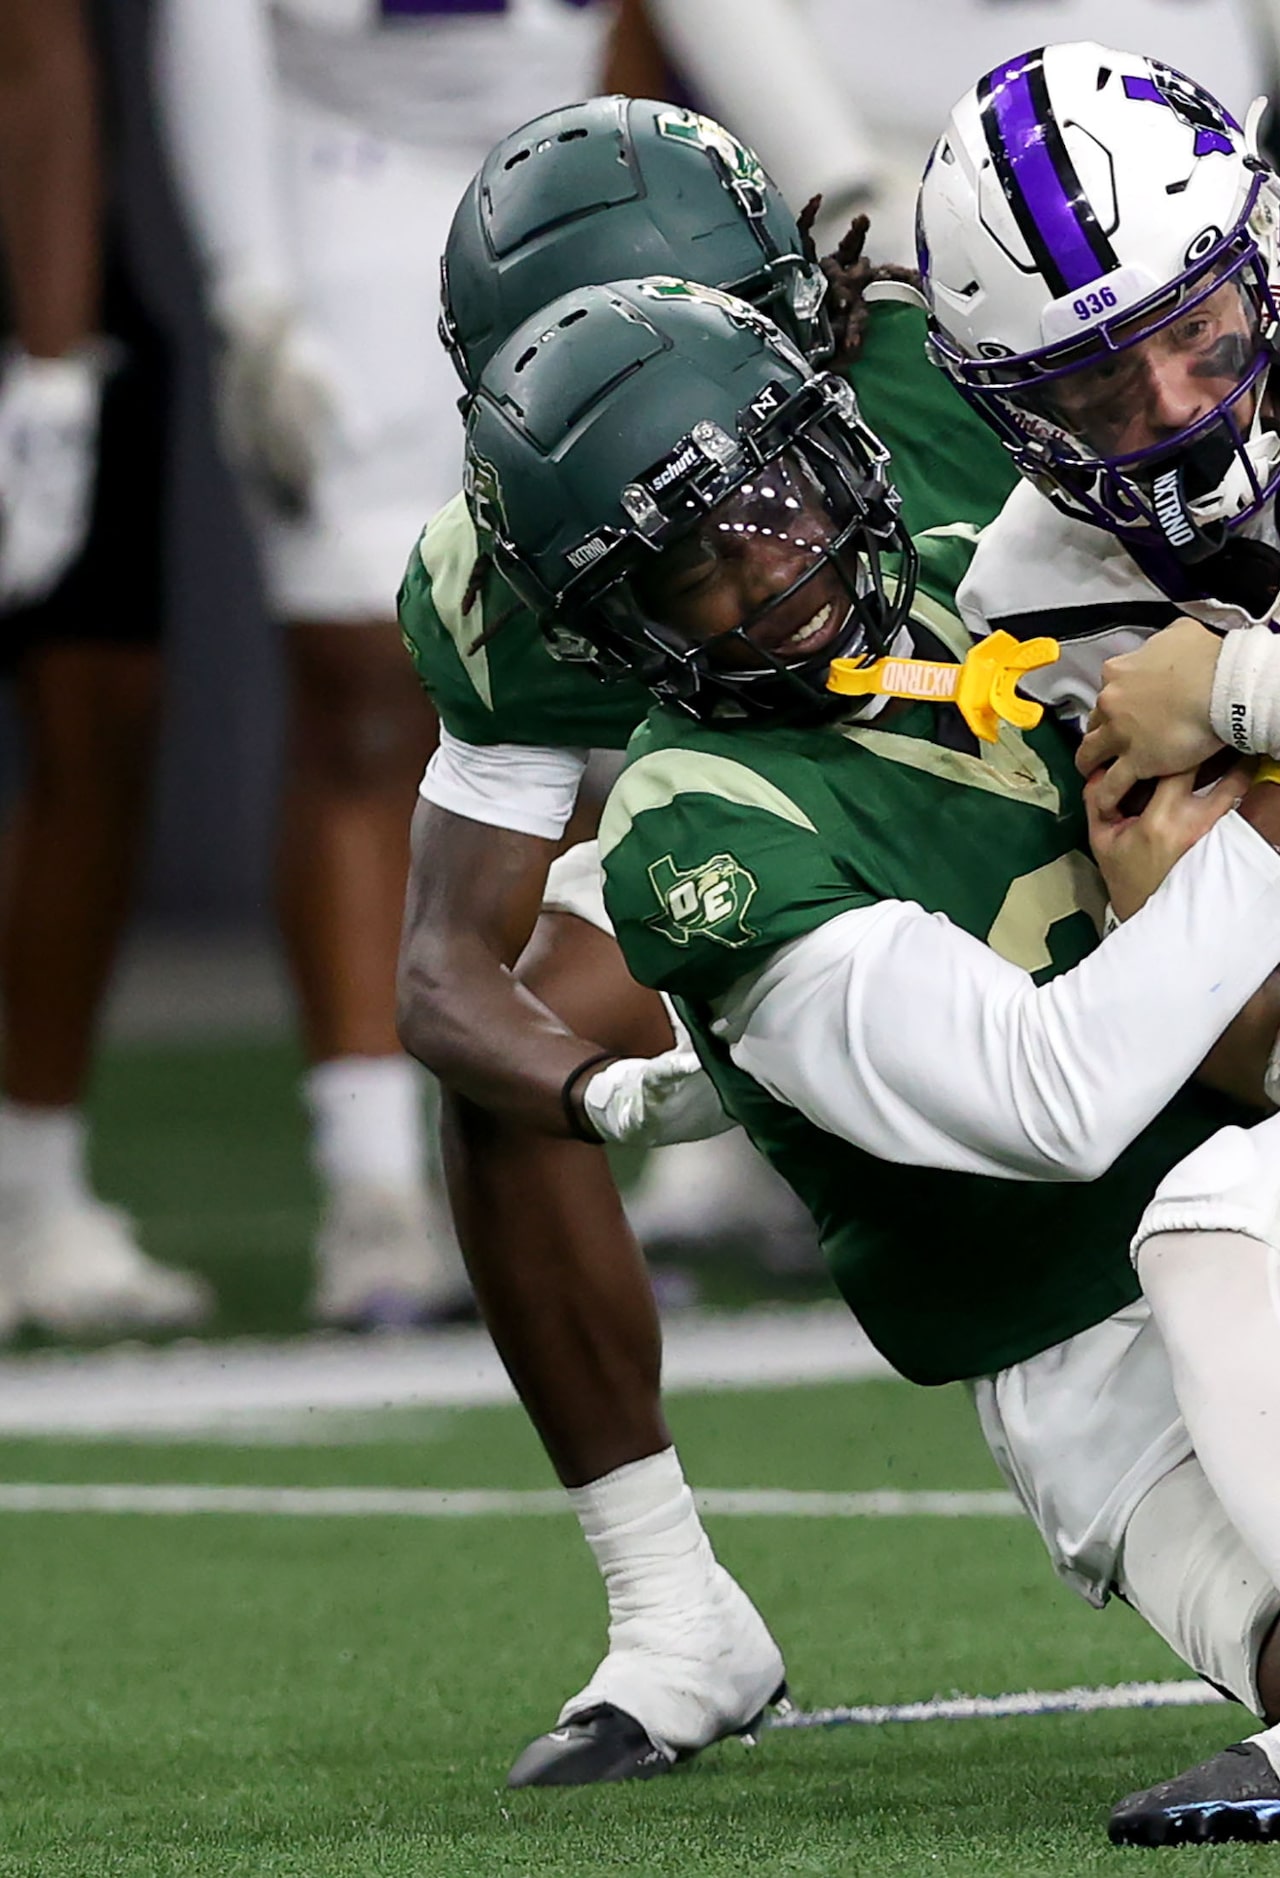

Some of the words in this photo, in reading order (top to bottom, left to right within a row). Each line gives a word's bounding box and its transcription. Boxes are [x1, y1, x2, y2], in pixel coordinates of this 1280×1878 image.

[1073, 286, 1117, 320] 936
[652, 447, 699, 491] schutt
[1153, 469, 1196, 546] NXTRND
[566, 538, 608, 569] NXTRND
[881, 661, 957, 697] NXTRND
[669, 880, 732, 923] DE
